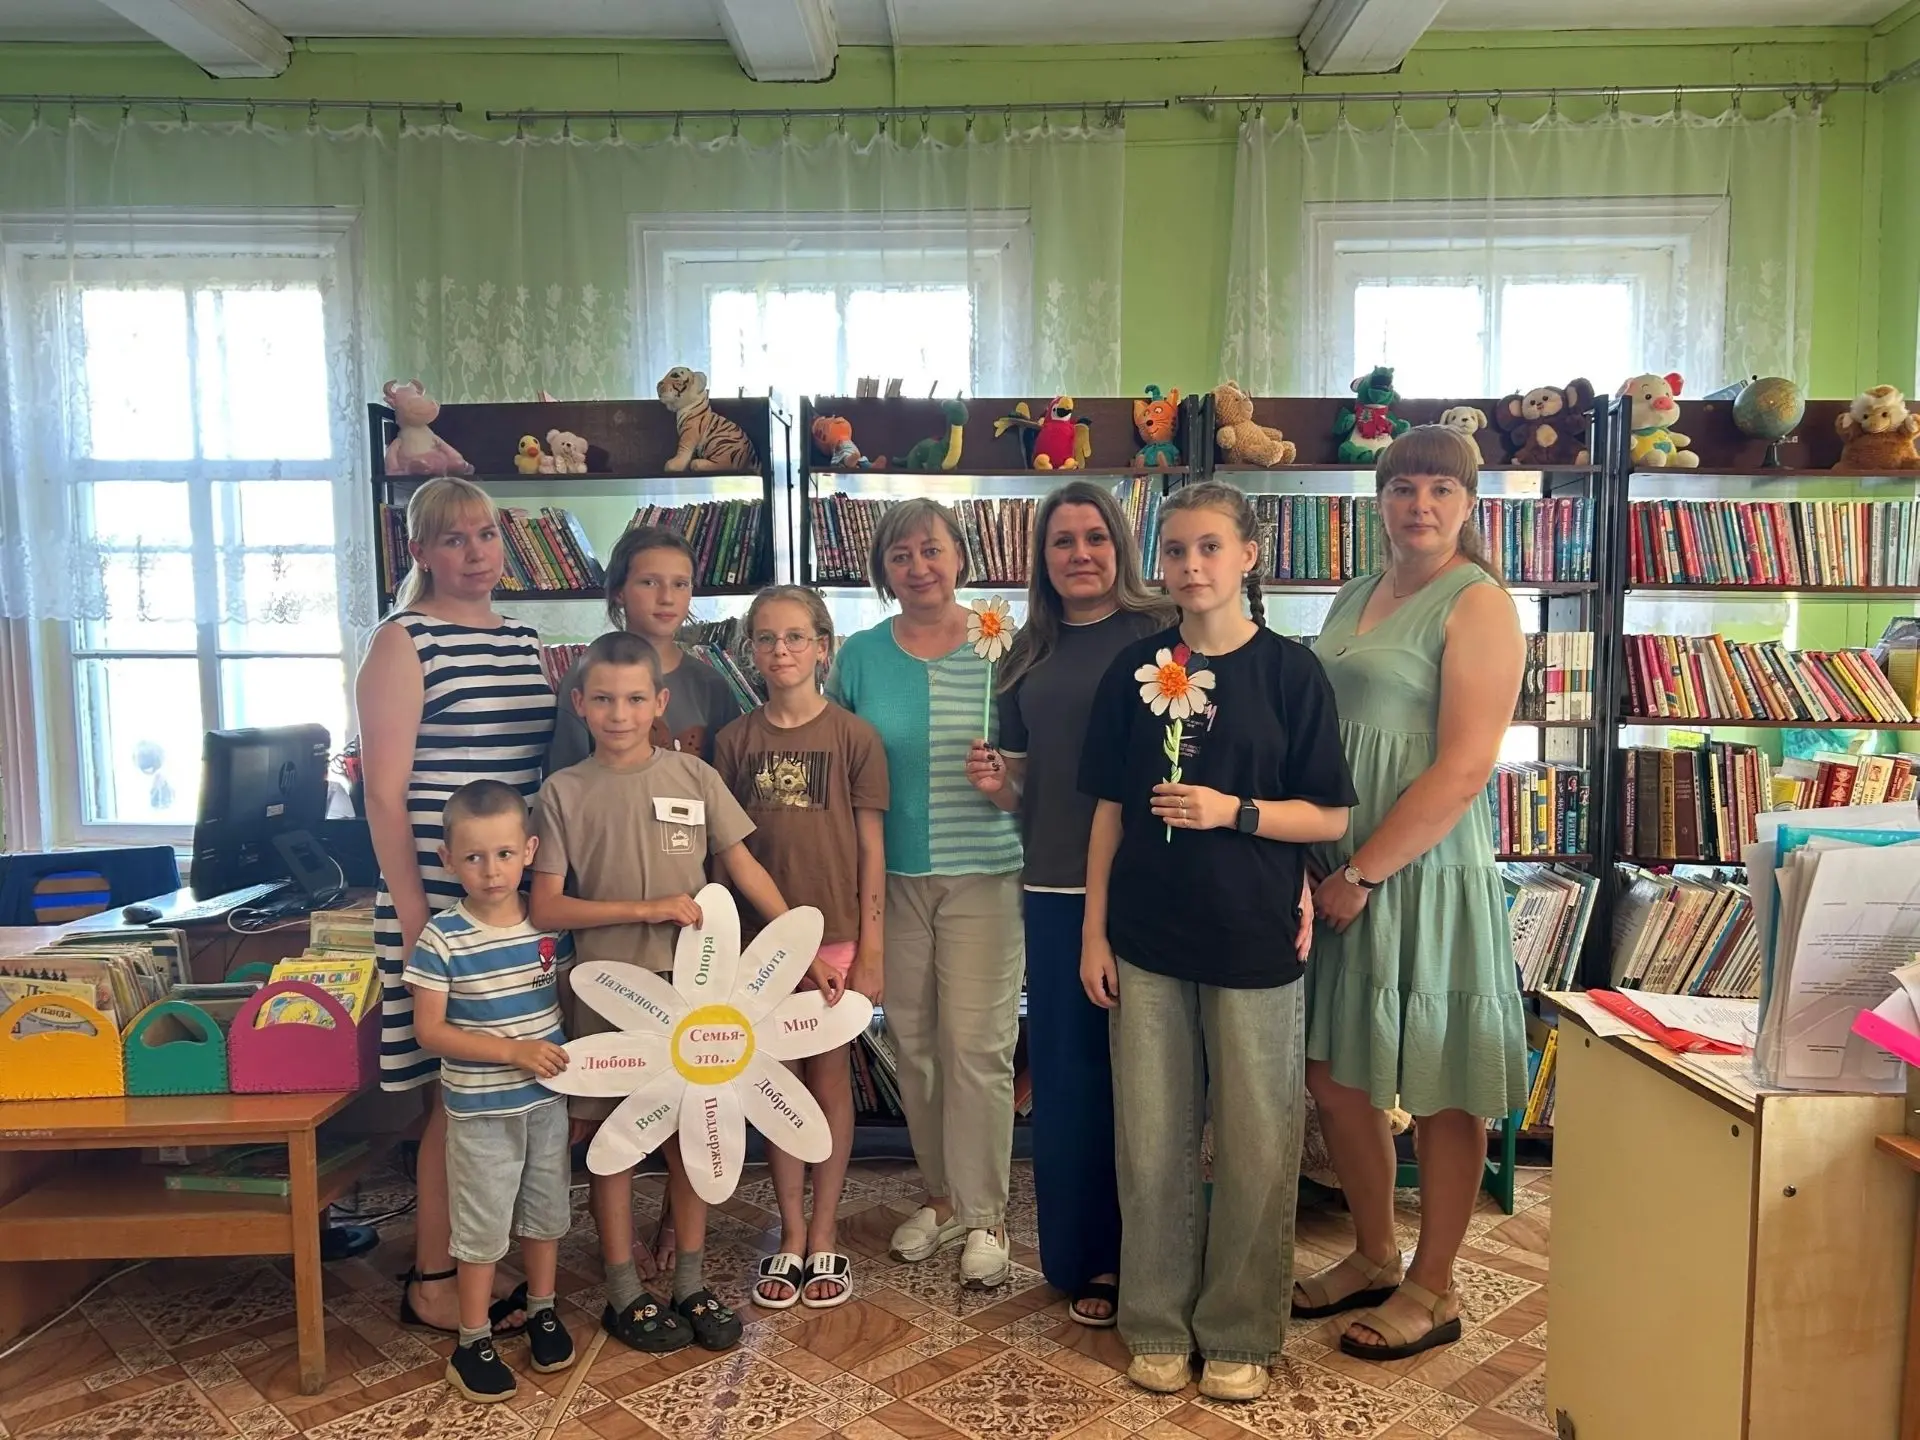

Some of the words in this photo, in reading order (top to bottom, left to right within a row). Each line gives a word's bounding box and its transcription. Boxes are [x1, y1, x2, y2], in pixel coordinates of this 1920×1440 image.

[694, 936, 714, 986] Опора
[747, 949, 786, 995] Забота
[594, 972, 671, 1027] Надежность
[689, 1027, 746, 1043] Семья-
[783, 1017, 819, 1035] Мир
[581, 1055, 647, 1071] Любовь
[635, 1103, 672, 1132] Вера
[753, 1078, 805, 1130] Доброта
[703, 1096, 724, 1180] Поддержка
